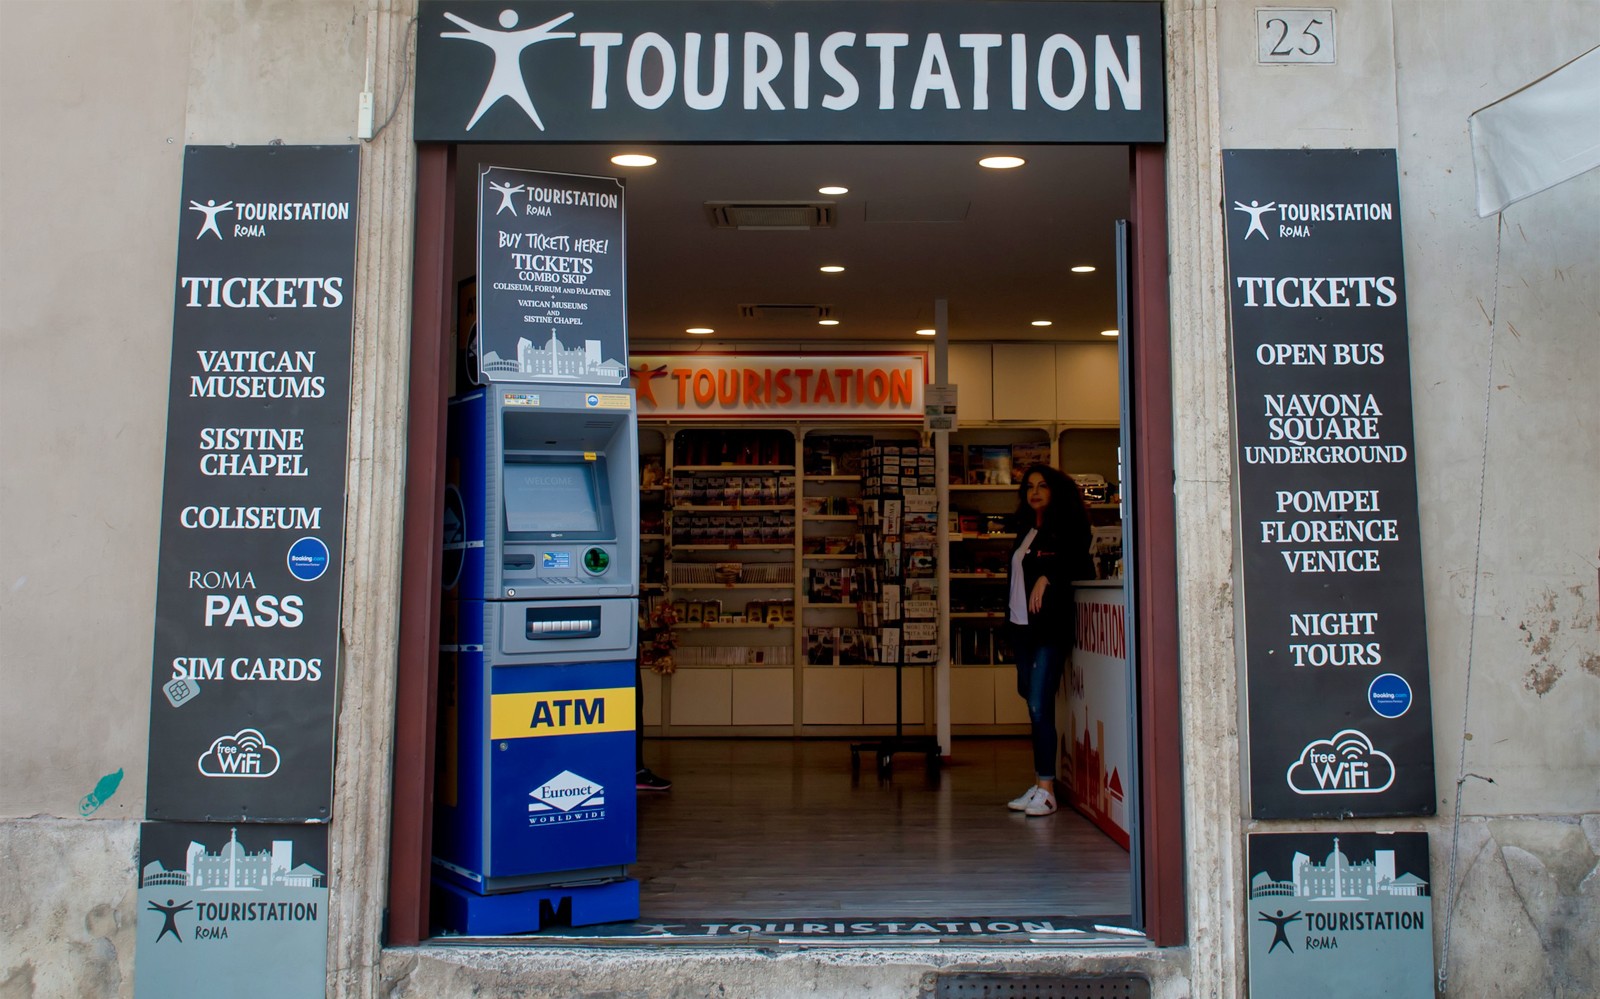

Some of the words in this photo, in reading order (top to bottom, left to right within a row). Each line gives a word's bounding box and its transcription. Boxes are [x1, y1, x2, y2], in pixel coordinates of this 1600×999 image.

[1265, 18, 1323, 56] 25
[579, 32, 1142, 111] TOURISTATION
[526, 186, 618, 209] TOURISTATION
[235, 202, 349, 221] TOURISTATION
[526, 204, 552, 217] ROMA
[1277, 203, 1392, 222] TOURISTATION
[233, 223, 266, 238] ROMA
[1279, 224, 1311, 238] ROMA
[499, 230, 522, 249] BUY
[525, 233, 570, 253] TICKETS
[574, 238, 609, 255] HERE!
[512, 253, 594, 275] TICKETS
[519, 270, 560, 283] COMBO
[562, 273, 588, 285] SKIP
[181, 276, 343, 308] TICKETS
[493, 282, 534, 293] COLISEUM,
[534, 284, 562, 294] FORUM
[576, 287, 611, 297] PALATINE
[1236, 276, 1397, 308] TICKETS
[518, 299, 550, 308] VATICAN
[551, 301, 588, 310] MUSEUMS
[523, 315, 552, 324] SISTINE
[553, 317, 583, 325] CHAPEL
[196, 350, 316, 373] VATICAN
[1256, 343, 1328, 366] OPEN
[1332, 343, 1385, 365] BUS
[189, 375, 326, 398] MUSEUMS
[671, 367, 914, 407] TOURISTATION
[1263, 393, 1383, 417] NAVONA
[199, 427, 305, 451] SISTINE
[1268, 417, 1380, 445] SQUARE
[199, 453, 309, 477] CHAPEL
[1244, 445, 1408, 464] UNDERGROUND
[1275, 490, 1381, 513] POMPEI
[180, 506, 322, 530] COLISEUM
[1260, 519, 1399, 543] FLORENCE
[291, 555, 325, 563] Booking.com
[1280, 549, 1381, 573] VENICE
[189, 571, 257, 589] ROMA
[204, 594, 304, 628] PASS
[1289, 612, 1378, 636] NIGHT
[1289, 642, 1382, 667] TOURS
[171, 657, 224, 681] SIM
[231, 657, 322, 682] CARDS
[529, 697, 605, 729] ATM
[217, 742, 237, 754] free
[1310, 748, 1336, 763] free
[217, 753, 261, 773] WiFi
[1311, 762, 1370, 789] WiFi
[541, 784, 592, 799] Euronet
[529, 810, 605, 824] WORLDWIDE
[196, 902, 318, 922] TOURISTATION
[1305, 911, 1424, 932] TOURISTATION
[195, 925, 229, 940] ROMA
[700, 921, 1056, 935] TOURISTATION
[1305, 935, 1338, 950] ROMA
